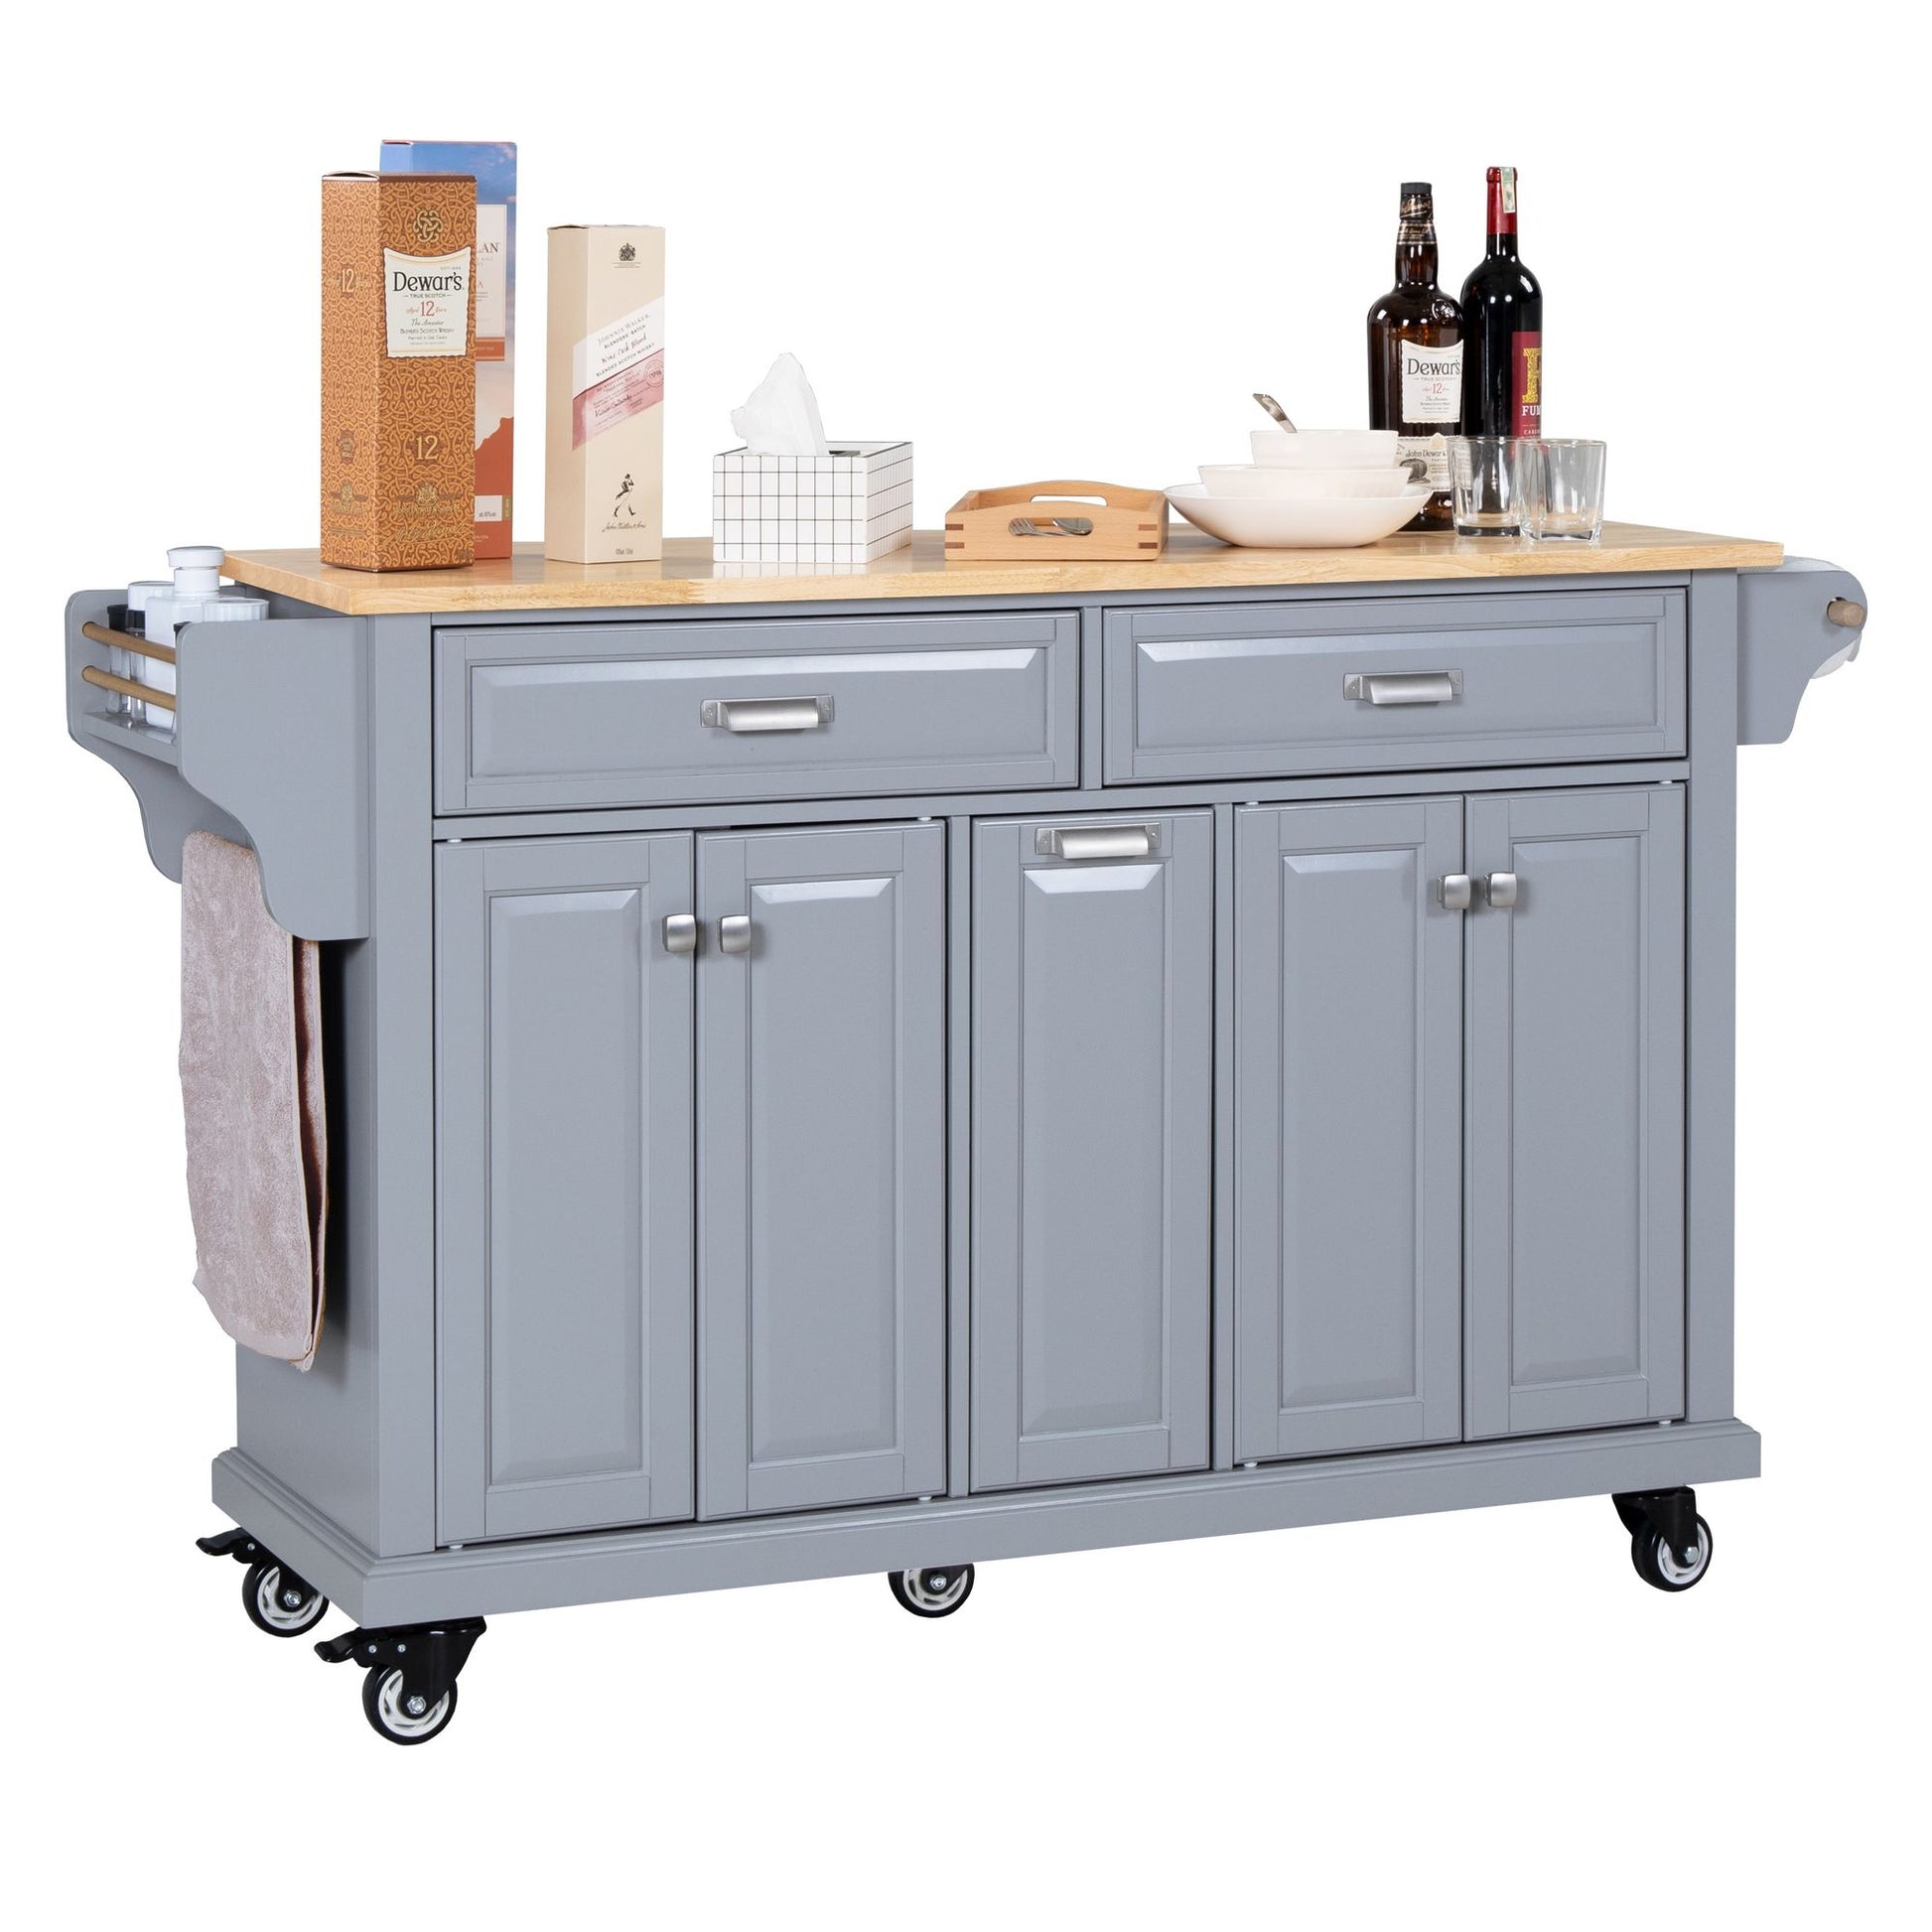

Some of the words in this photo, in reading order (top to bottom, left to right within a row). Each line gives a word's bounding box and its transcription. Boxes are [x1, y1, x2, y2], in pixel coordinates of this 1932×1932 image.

[342, 268, 354, 293] 12
[393, 271, 463, 292] Dewar's
[421, 301, 435, 317] 12
[1407, 358, 1460, 375] Dewar's
[1433, 383, 1443, 394] 12
[416, 435, 439, 460] 12
